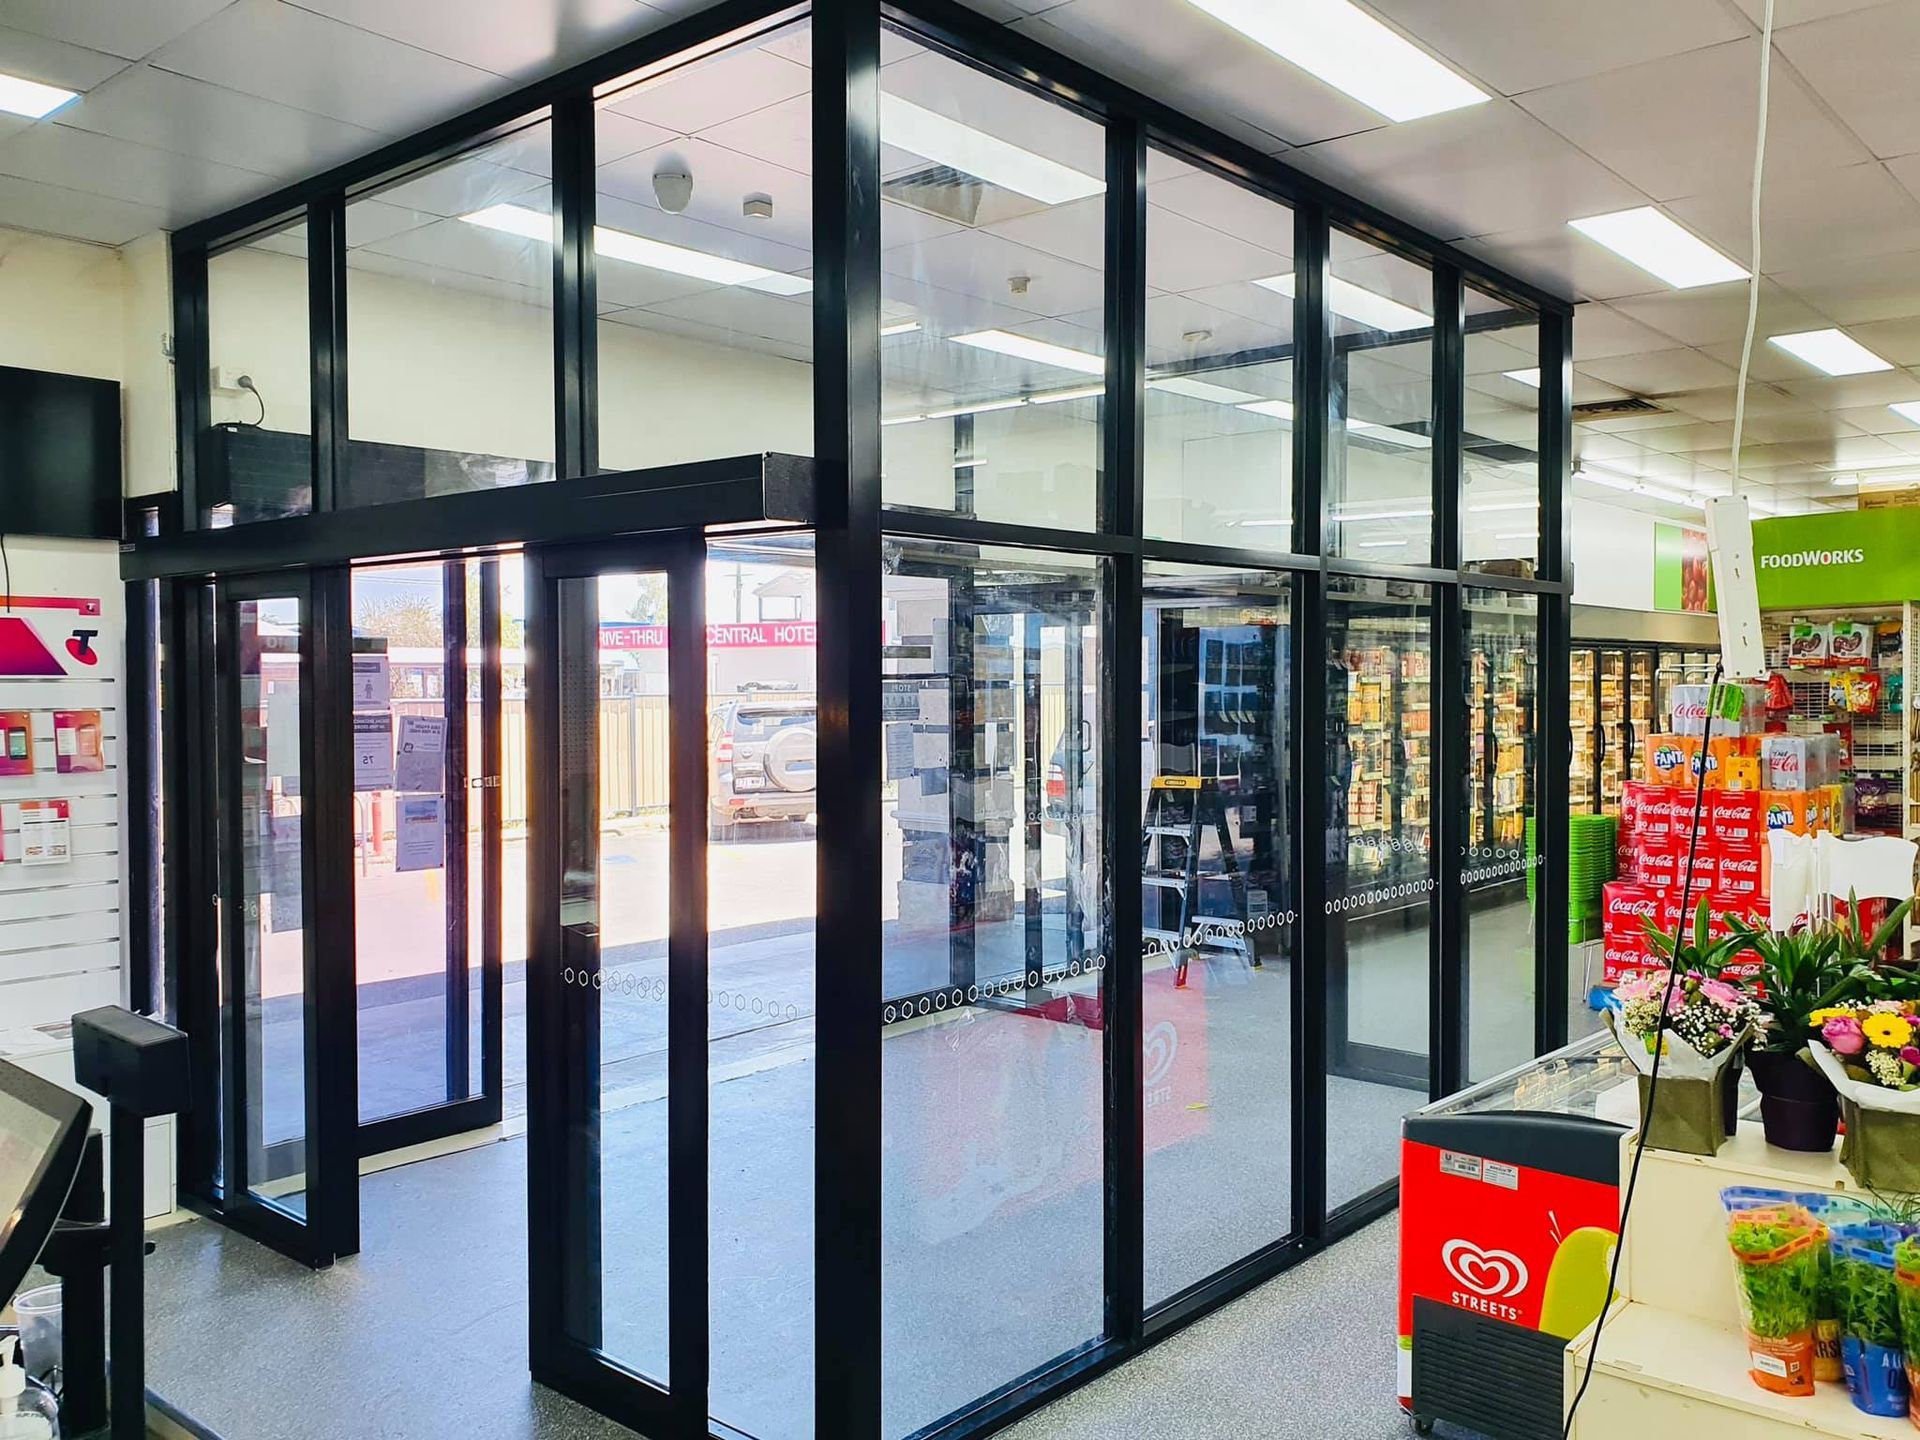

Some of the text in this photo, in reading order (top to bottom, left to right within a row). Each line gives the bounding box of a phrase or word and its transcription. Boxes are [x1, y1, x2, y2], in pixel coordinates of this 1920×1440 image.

[1760, 548, 1865, 569] FOODWORKS
[707, 627, 767, 645] CENTRAL
[1714, 805, 1753, 820] Coca-Cola
[1639, 854, 1675, 868] Coca-Cola
[1720, 858, 1759, 873] Coca-Cola
[1609, 897, 1659, 918] Coca-Cola
[1605, 948, 1640, 963] Coca-Cola
[1451, 1290, 1518, 1321] STREETS
